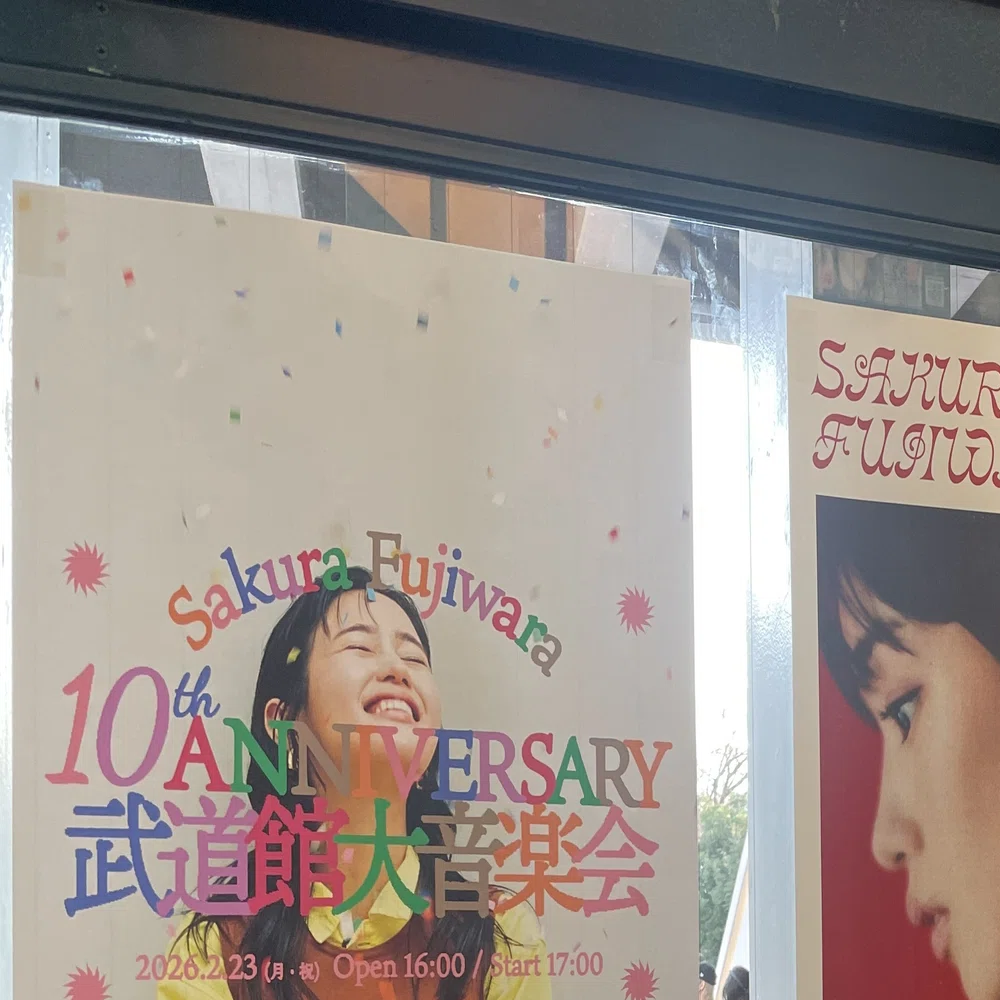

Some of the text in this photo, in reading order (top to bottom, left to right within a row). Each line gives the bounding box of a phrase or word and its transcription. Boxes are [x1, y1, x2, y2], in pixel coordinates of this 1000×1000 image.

[168, 530, 562, 678] Sakura Fujiwara
[45, 663, 673, 809] 10th ANNIVERSARY
[64, 791, 660, 918] 武道館大音楽会
[135, 953, 257, 981] 2026.2.23
[333, 953, 398, 987] Open
[403, 952, 466, 979] 16:00
[490, 952, 541, 977] Start
[547, 951, 604, 977] 17:00
